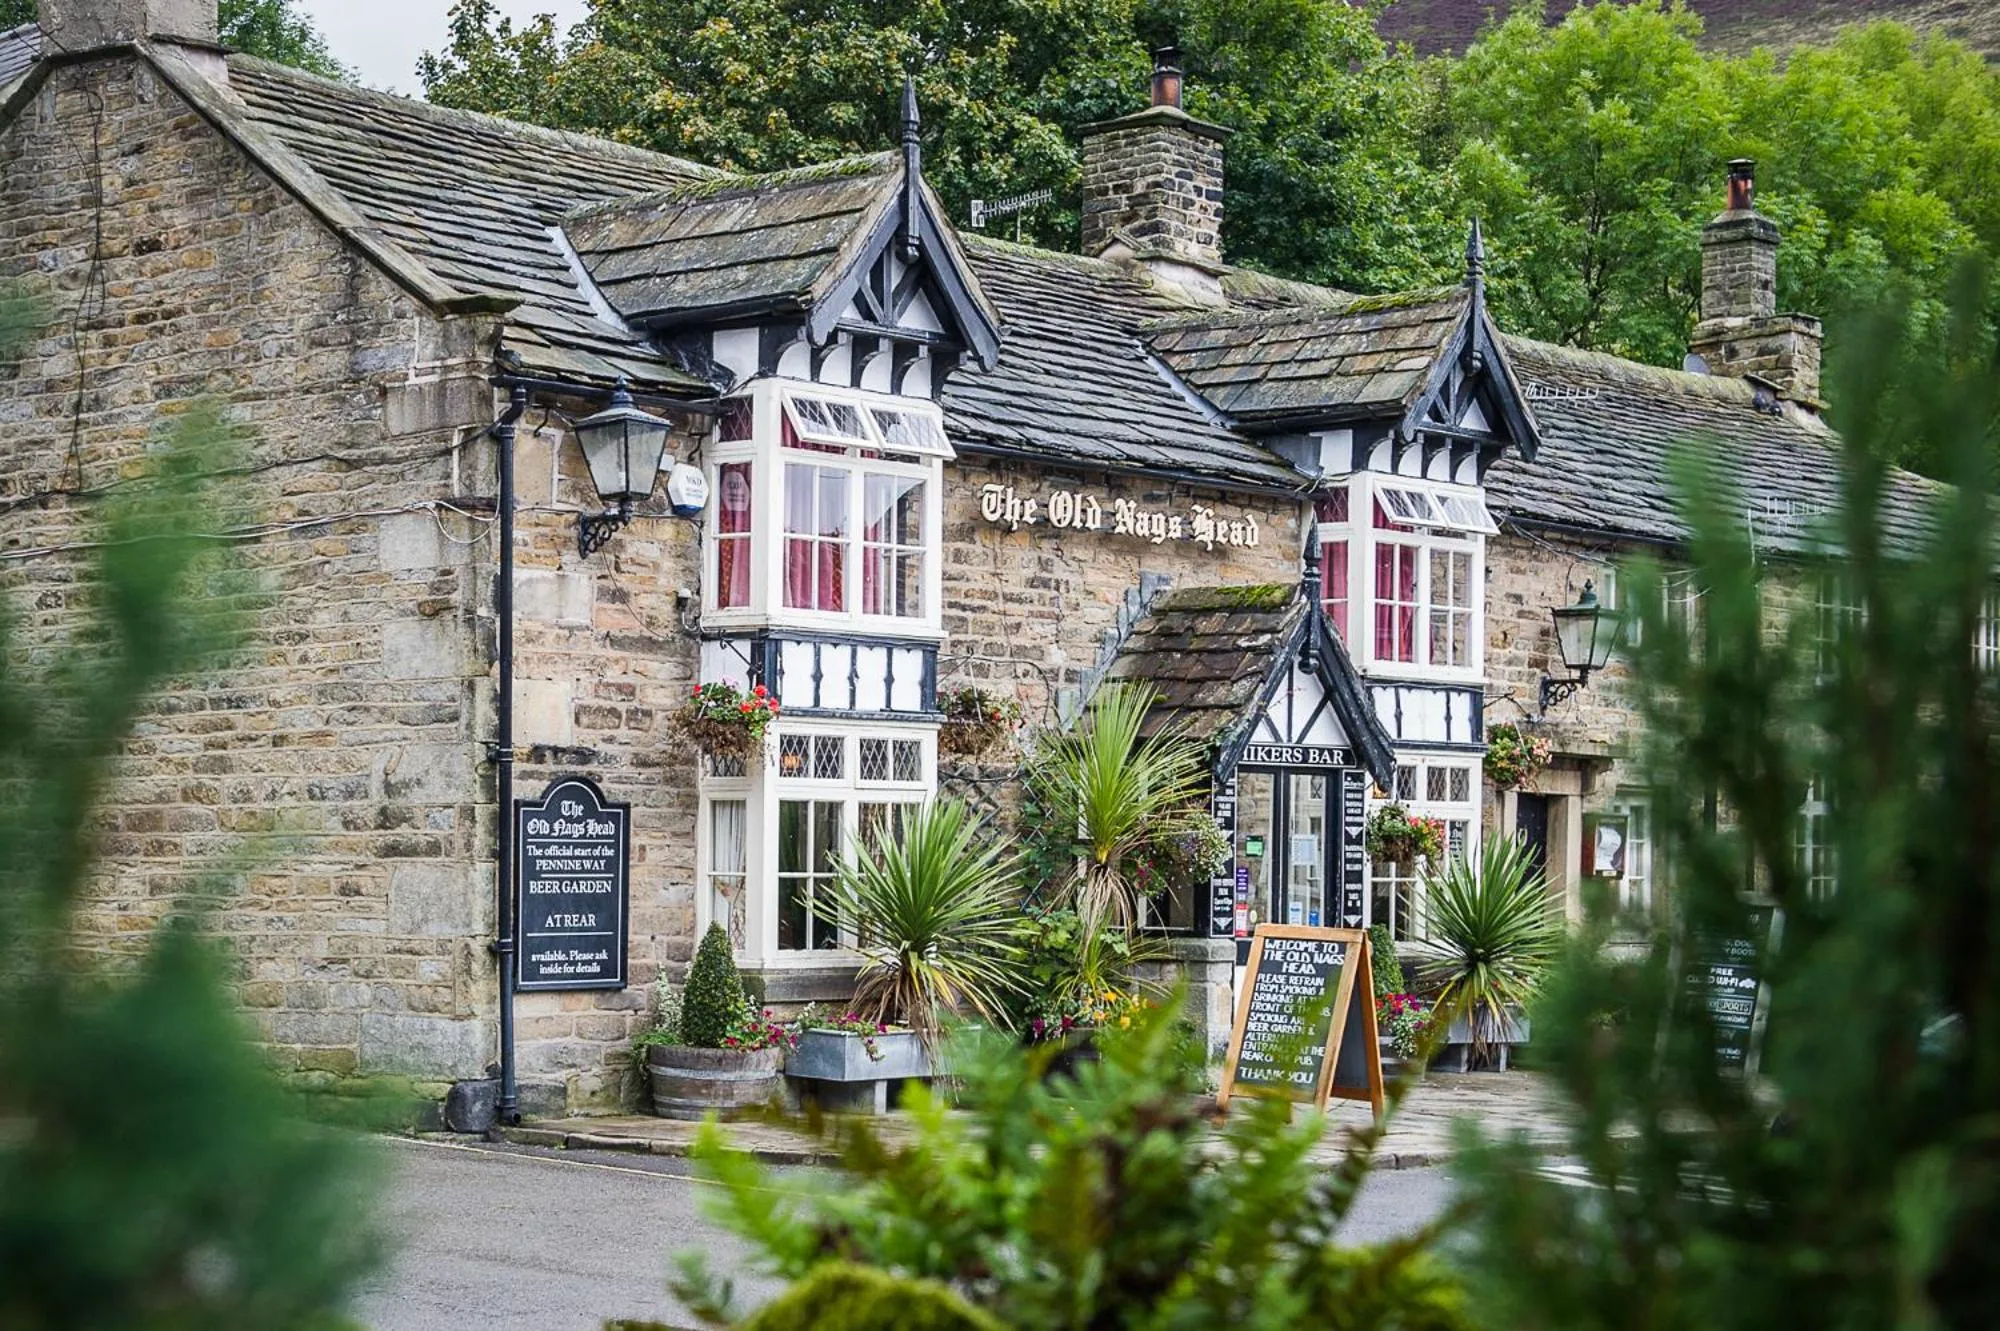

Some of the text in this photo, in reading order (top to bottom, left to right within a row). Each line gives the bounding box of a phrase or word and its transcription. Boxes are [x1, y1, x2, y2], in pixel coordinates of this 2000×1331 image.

[980, 483, 1260, 551] The Old Nags Head
[1308, 748, 1344, 765] BAR
[560, 800, 584, 819] The
[527, 818, 615, 838] Old Nags Head
[526, 844, 615, 856] The official start of the
[535, 859, 606, 871] PENNINE WAY
[529, 880, 612, 894] BEER GARDEN
[545, 914, 596, 928] AT REAR
[1265, 939, 1339, 953] WELCOME TO
[569, 950, 594, 961] Please
[595, 949, 608, 960] ask
[1264, 950, 1344, 965] THE OLD NAGS
[539, 962, 601, 974] inside for details
[1282, 962, 1316, 974] HEAD
[1257, 973, 1325, 987] PLEASE REFRAIN
[1255, 983, 1279, 993] FROM
[1279, 984, 1317, 996] SMOKING
[1253, 992, 1294, 1003] DRINKING
[1251, 1001, 1281, 1013] FRONT
[1249, 1012, 1288, 1024] SMOKING
[1247, 1022, 1270, 1032] BEER
[1240, 1051, 1264, 1061] REAR
[1240, 1066, 1314, 1084] THANK YOU
